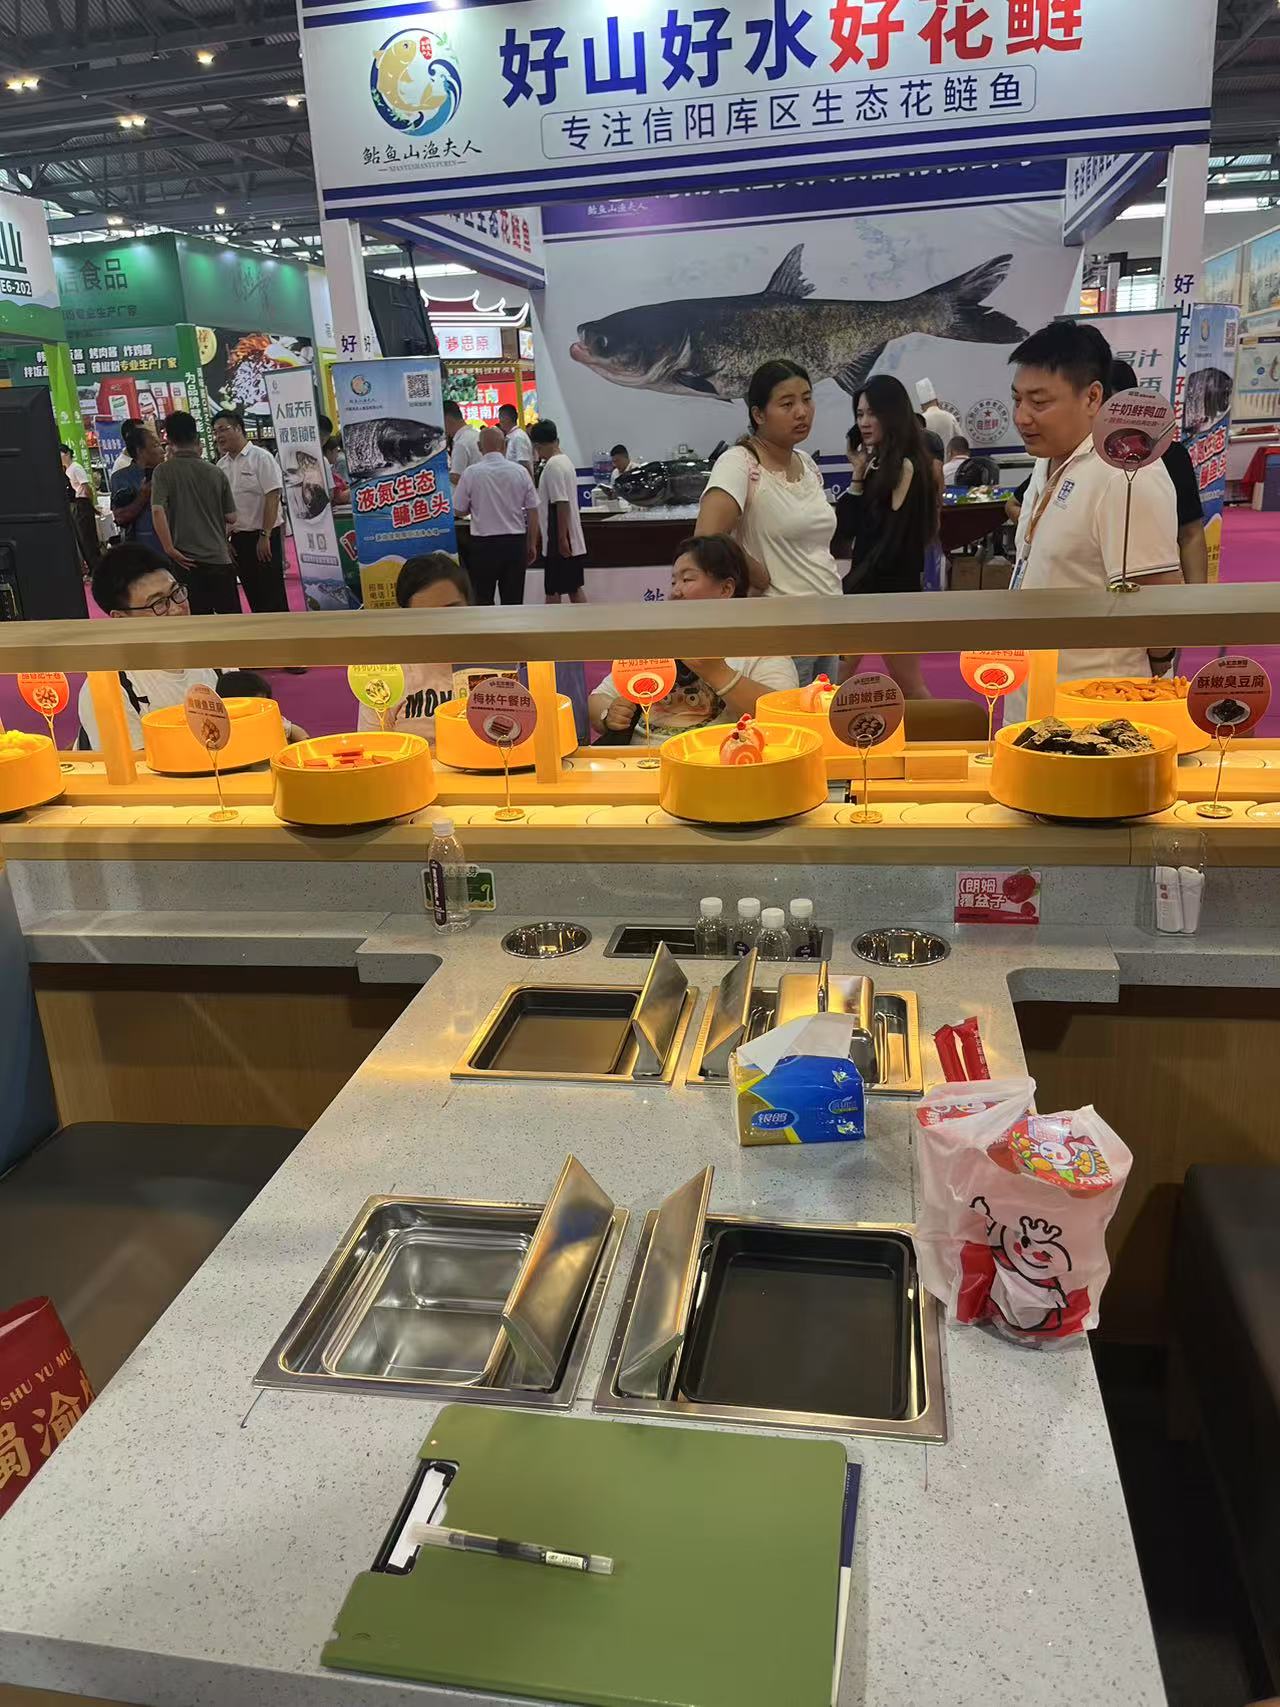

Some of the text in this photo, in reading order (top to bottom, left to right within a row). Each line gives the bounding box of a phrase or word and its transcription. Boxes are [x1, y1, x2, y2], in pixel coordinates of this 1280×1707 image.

[499, 0, 1083, 109] 好山好水好花鲢
[561, 71, 1022, 151] 专注信阳库区生态花鲢鱼
[362, 137, 483, 165] 鲇鱼山渔夫人
[1197, 675, 1265, 689] 酥嫩臭豆腐
[473, 693, 531, 708] 梅林午餐肉
[836, 688, 897, 706] 山韵嫩香菇
[959, 893, 1007, 909] 覆盆子
[1, 1378, 33, 1411] SHU
[35, 1362, 54, 1384] YU
